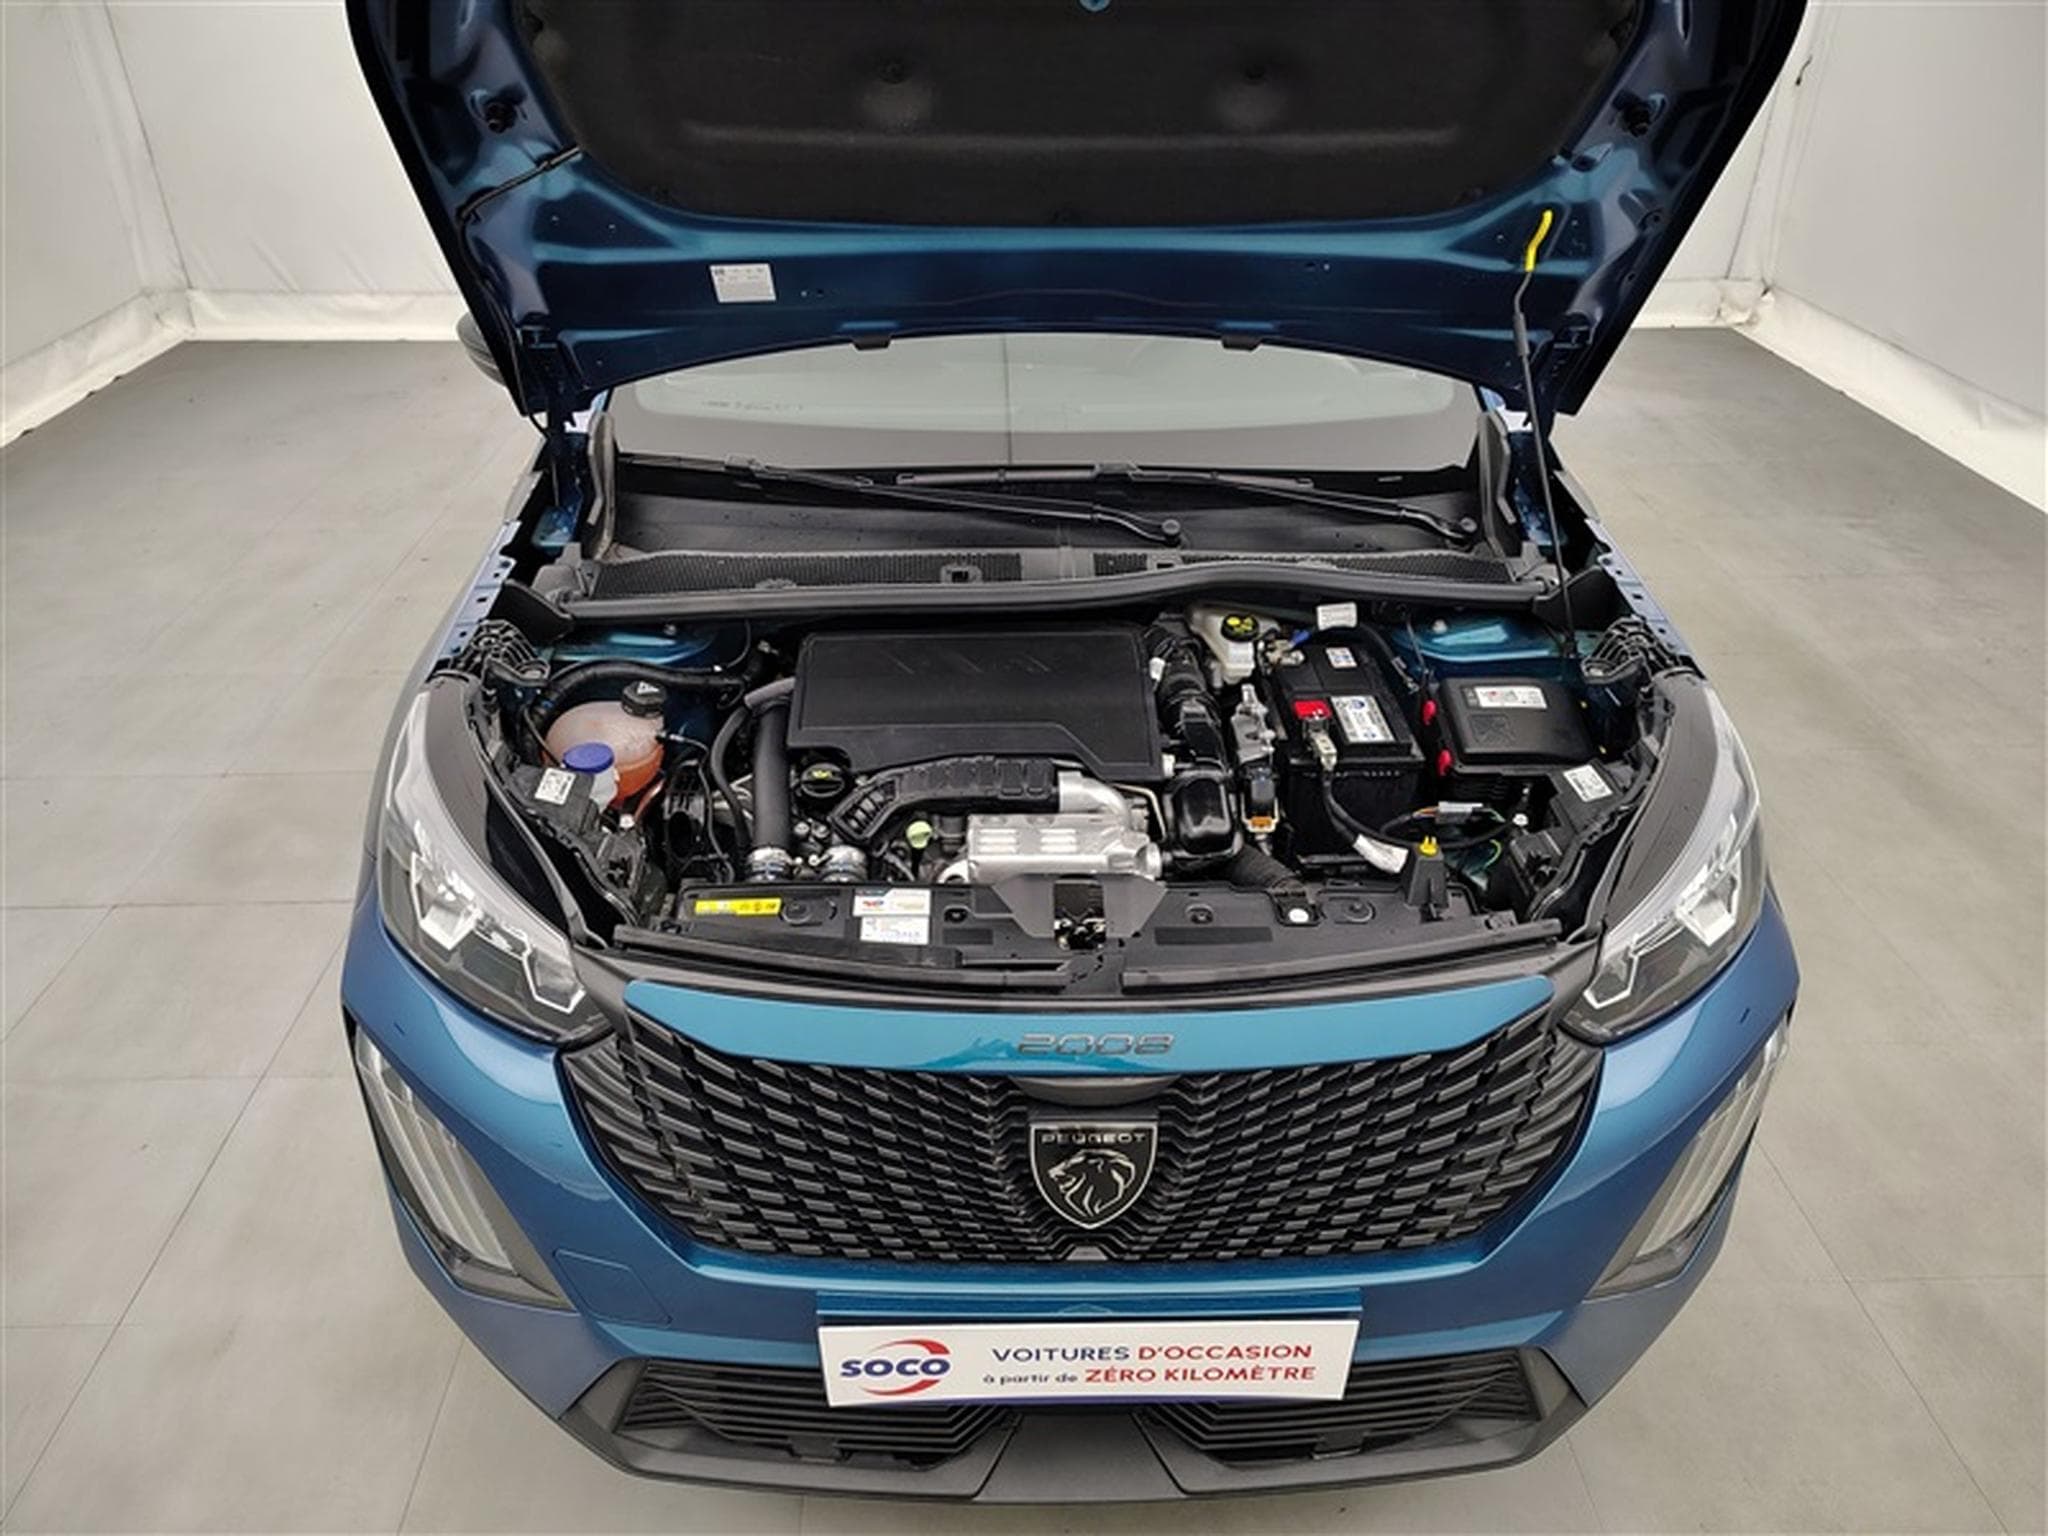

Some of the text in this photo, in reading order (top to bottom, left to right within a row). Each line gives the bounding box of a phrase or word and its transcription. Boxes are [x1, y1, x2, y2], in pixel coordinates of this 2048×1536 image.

[1018, 1033, 1174, 1055] 2008
[1041, 1132, 1146, 1144] PEUGEOT
[992, 1344, 1312, 1362] VOITURES D'OCCASION
[840, 1358, 950, 1377] SOCO
[1000, 1371, 1050, 1386] partir
[1055, 1371, 1078, 1384] de
[1085, 1365, 1156, 1383] ZÉRO
